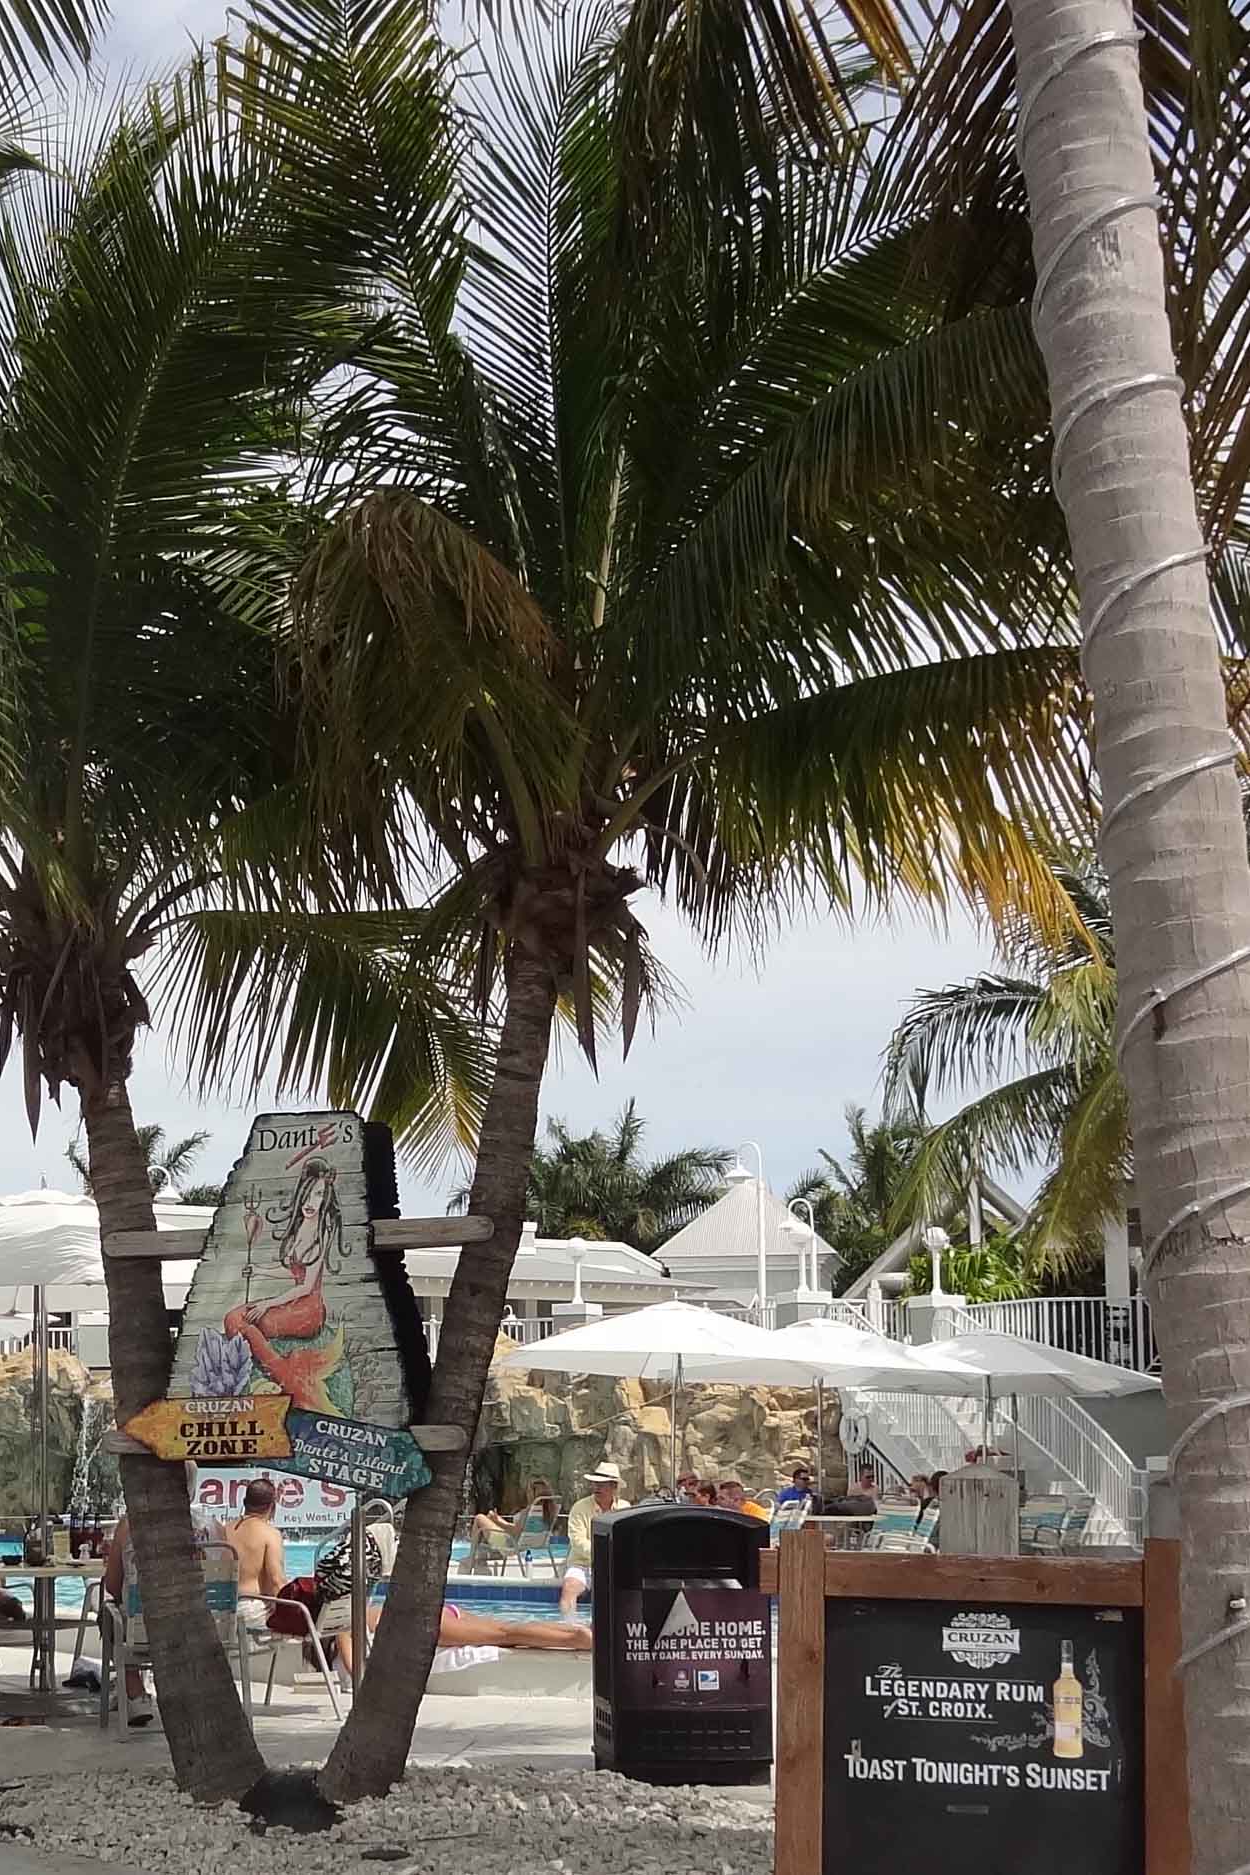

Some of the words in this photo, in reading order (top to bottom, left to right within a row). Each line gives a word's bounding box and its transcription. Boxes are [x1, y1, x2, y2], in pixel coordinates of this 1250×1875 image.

[185, 1400, 254, 1413] CRUZAN
[180, 1420, 264, 1438] CHILL
[316, 1420, 388, 1447] CRUZAN
[186, 1439, 257, 1456] ZONE
[293, 1439, 349, 1463] Dante's
[354, 1453, 408, 1475] Island
[308, 1458, 385, 1489] STAGE
[715, 1620, 766, 1636] HOME.
[626, 1639, 649, 1650] THE
[654, 1639, 678, 1650] ONE
[680, 1637, 719, 1649] PLACE
[721, 1637, 737, 1649] TO
[741, 1637, 762, 1649] GET
[948, 1631, 1015, 1644] CRUZAN
[626, 1651, 656, 1661] EVERY
[659, 1651, 690, 1661] GAME.
[691, 1650, 722, 1660] EVERY
[724, 1649, 764, 1660] SUNDAY.
[865, 1676, 989, 1701] LEGENDARY
[996, 1682, 1044, 1703] RUM
[897, 1698, 923, 1716] ST.
[928, 1701, 993, 1719] CROIX.
[844, 1754, 907, 1781] TOAST
[911, 1757, 1020, 1787] TONIGHT'S
[1025, 1763, 1111, 1791] SUNSET
